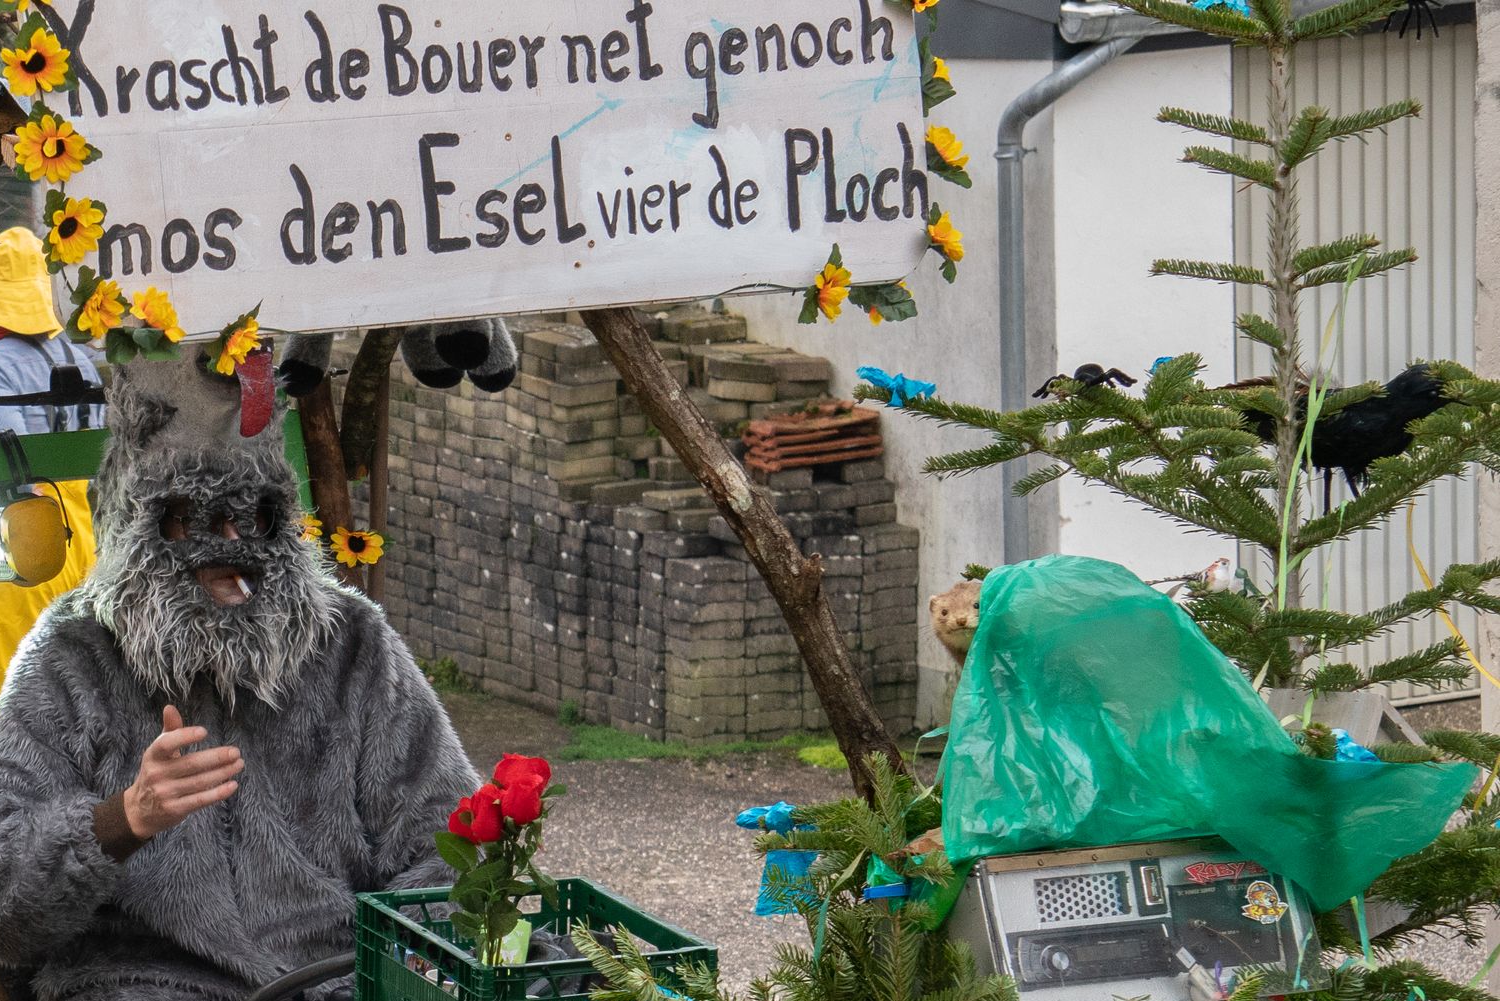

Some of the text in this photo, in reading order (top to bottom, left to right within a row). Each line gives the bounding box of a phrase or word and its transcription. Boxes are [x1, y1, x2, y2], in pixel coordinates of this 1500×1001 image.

[304, 10, 370, 102] de
[378, 4, 546, 96] Bouer
[561, 0, 664, 84] net
[685, 0, 896, 129] genoch
[98, 208, 243, 280] mos
[280, 164, 407, 265] den
[596, 167, 692, 238] vier
[708, 145, 759, 229] de
